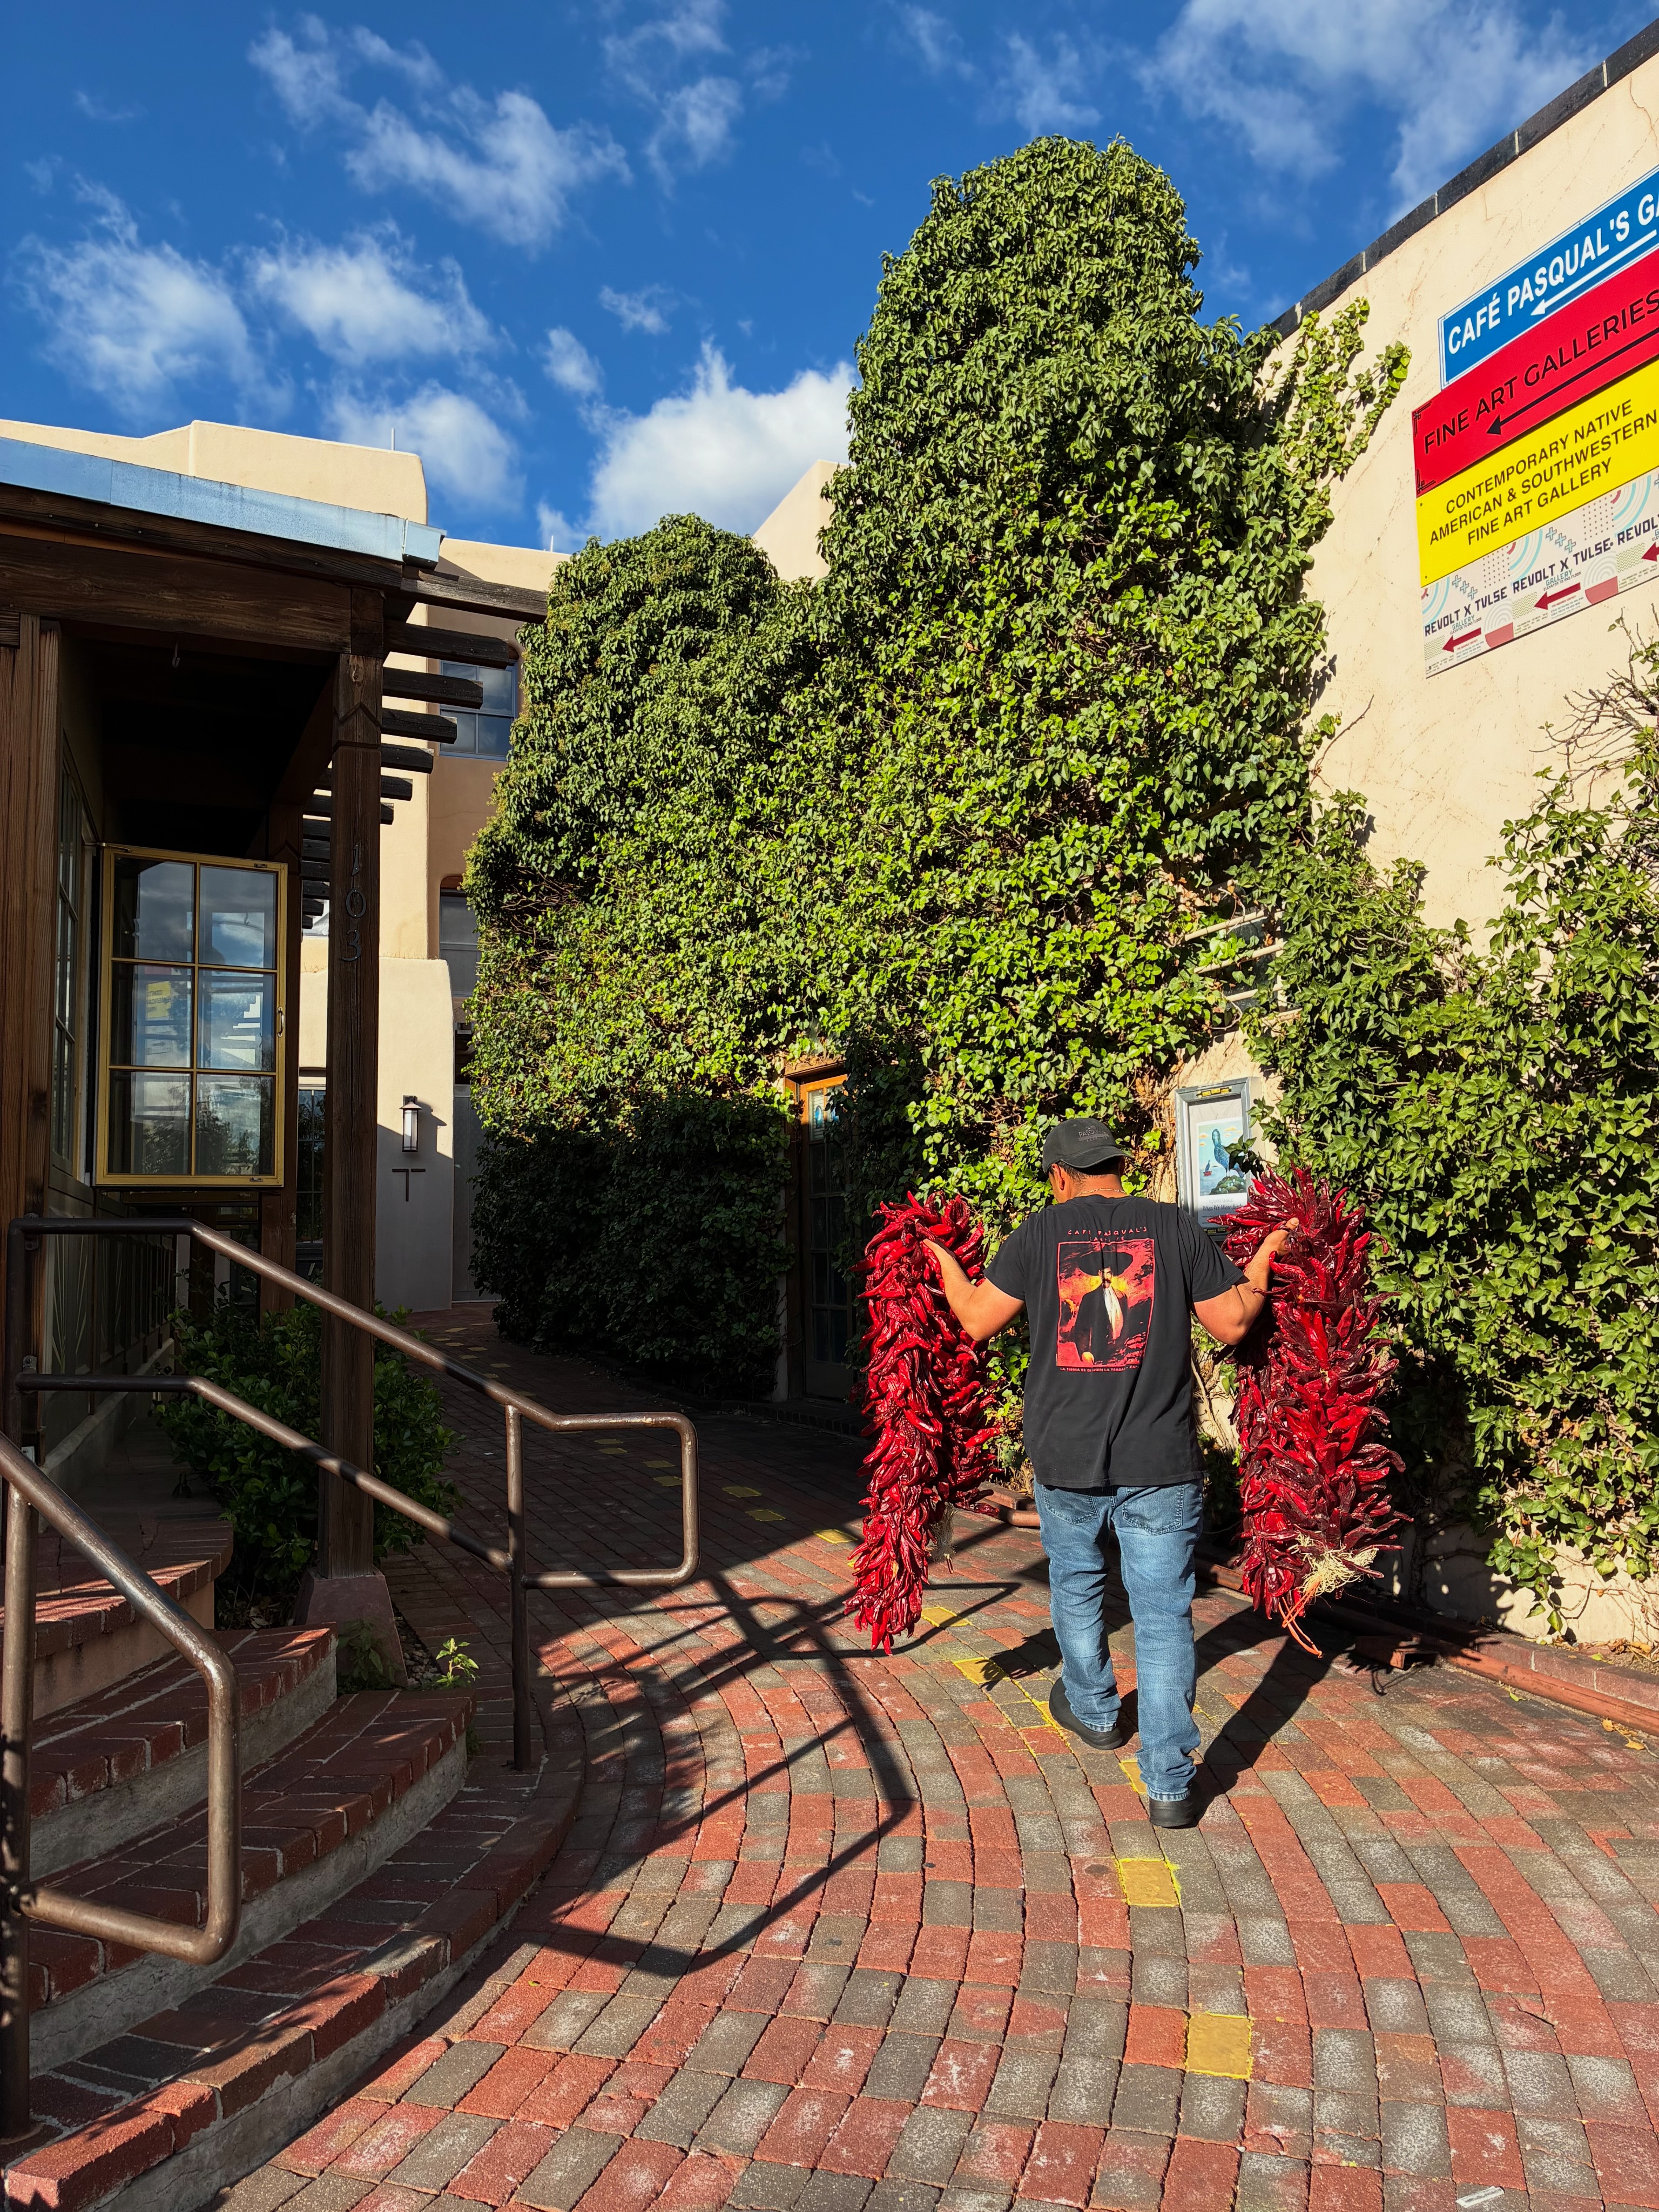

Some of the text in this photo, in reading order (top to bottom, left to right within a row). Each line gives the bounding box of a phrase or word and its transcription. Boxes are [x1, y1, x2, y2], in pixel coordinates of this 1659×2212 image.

[1448, 190, 1659, 354] CAFÉ PASQUAL'S G
[1424, 408, 1470, 454] FINE
[1475, 376, 1518, 422] ART
[1446, 399, 1632, 514] CONTEMPORARY NATIVE
[1429, 409, 1658, 545] AMERICAN & SOUTHWESTERN
[1468, 457, 1612, 545] FINE ART GALLERY
[1513, 563, 1555, 594] REVOLT
[1560, 557, 1569, 572] X
[1617, 514, 1659, 545] REVOL
[1546, 569, 1573, 586] GALLERY
[1425, 609, 1460, 637] REVOLT
[1464, 603, 1472, 617] X
[1452, 614, 1475, 630] GALLERY
[341, 842, 366, 961] 103
